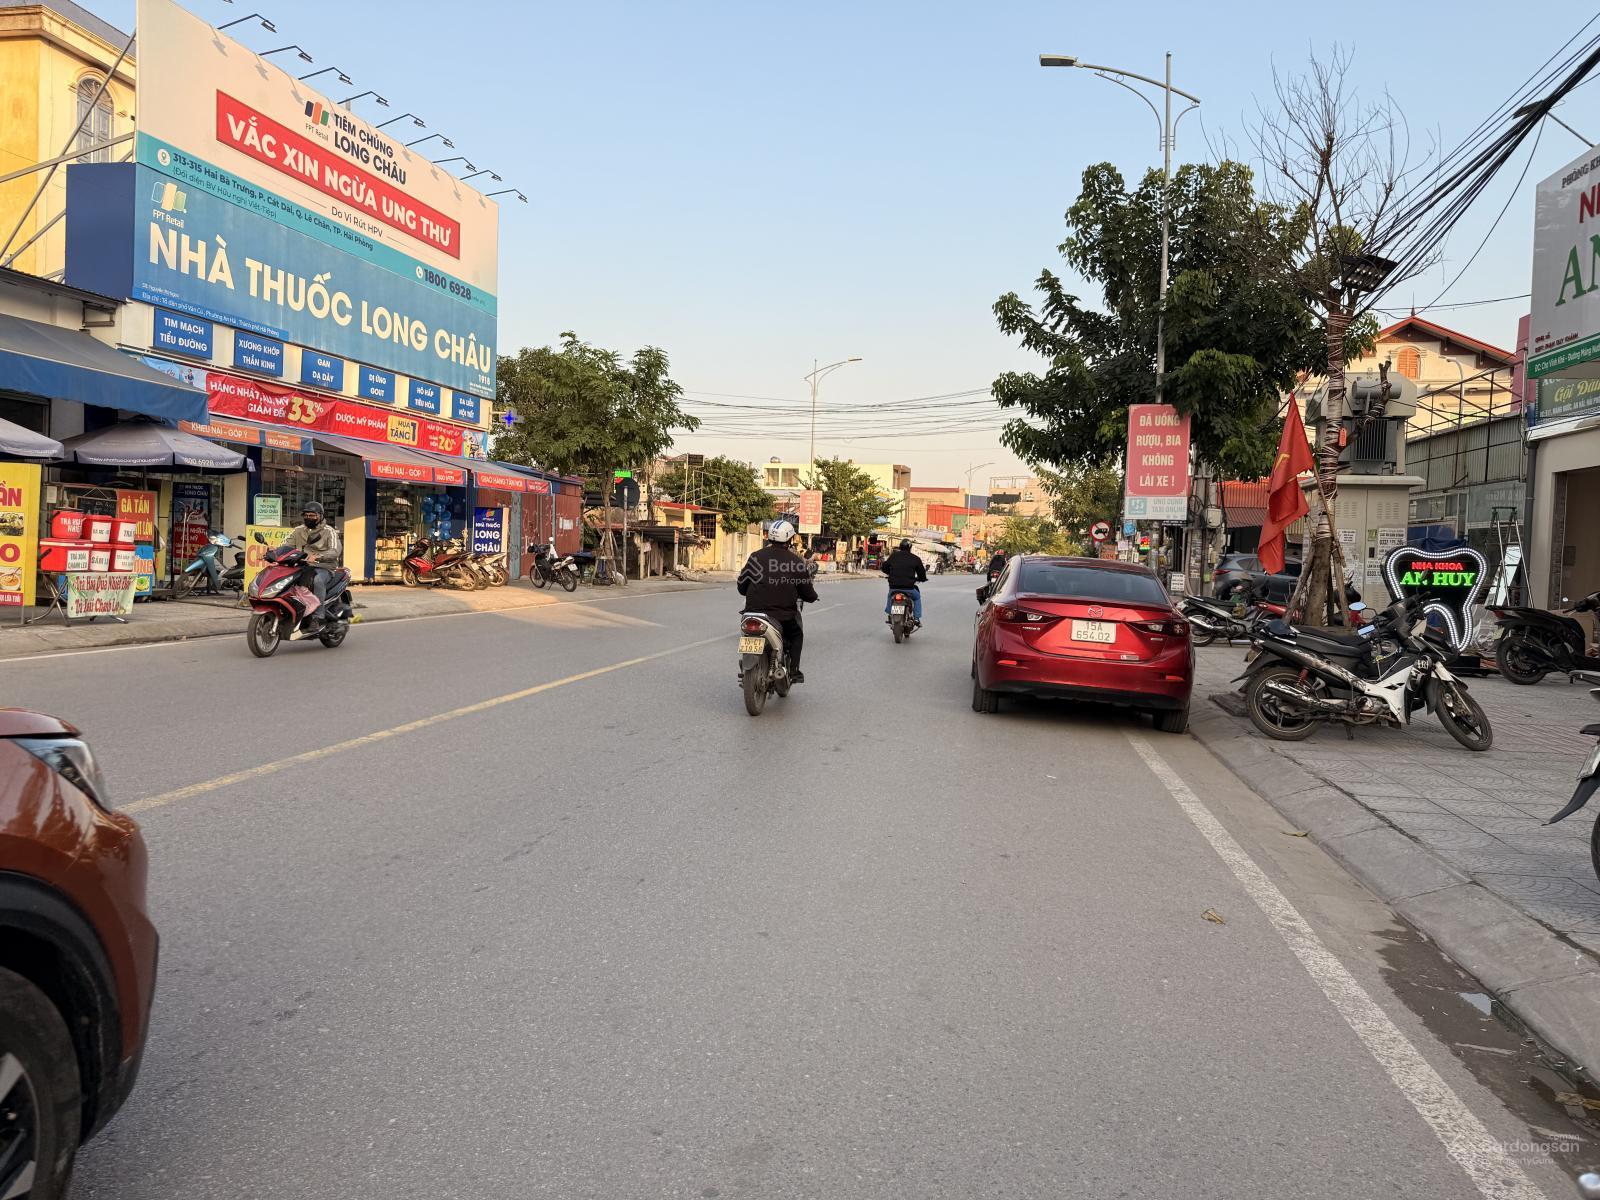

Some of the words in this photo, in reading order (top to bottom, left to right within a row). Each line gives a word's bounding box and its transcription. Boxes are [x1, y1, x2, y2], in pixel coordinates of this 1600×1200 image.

[305, 123, 315, 134] FPT
[316, 128, 329, 142] Retail
[334, 113, 356, 137] TIÊM
[359, 130, 393, 158] CHỦNG
[334, 132, 370, 164] LONG
[373, 154, 406, 185] CHÂU
[226, 113, 277, 159] VẮC
[283, 142, 319, 181] XIN
[325, 165, 377, 211] NGỪA
[382, 196, 417, 230] UNG
[420, 216, 452, 247] THƯ
[1561, 163, 1589, 189] PHÒNG
[206, 181, 217, 192] BV
[173, 152, 202, 172] 313-315
[204, 167, 218, 180] Hai
[219, 173, 231, 186] Bà
[232, 179, 257, 199] Trưng,
[258, 192, 265, 202] P.
[296, 210, 303, 219] Q.
[313, 217, 332, 233] Chân,
[333, 226, 343, 237] TP.
[343, 230, 354, 242] Hải
[354, 237, 374, 252] Phòng
[153, 209, 165, 220] FPT
[166, 214, 184, 228] Retail
[331, 206, 343, 219] Do
[353, 216, 367, 230] Rút
[368, 224, 383, 238] HPV
[424, 268, 447, 291] 1800
[450, 280, 472, 301] 6928
[149, 221, 235, 290] NHÀ
[245, 256, 353, 327] THUỐC
[361, 300, 428, 351] LONG
[434, 329, 491, 373] CHÂU
[164, 317, 178, 329] TIM
[180, 320, 204, 335] MẠCH
[160, 330, 176, 345] TIỂU
[178, 335, 208, 352] ĐƯỜNG
[239, 339, 262, 352] XƯƠNG
[263, 343, 280, 356] KHỚP
[261, 360, 275, 370] KINH
[317, 358, 331, 369] GAN
[312, 371, 321, 380] DẠ
[210, 381, 235, 395] HÀNG
[275, 395, 289, 406] MỸ
[370, 387, 385, 397] GOUT
[247, 402, 272, 417] GIẢM
[335, 412, 356, 426] DƯỢC
[356, 415, 367, 425] MỸ
[397, 420, 411, 429] MUA
[1140, 413, 1152, 427] ĐÃ
[1155, 411, 1180, 427] UỐNG
[390, 428, 411, 440] TẶNG
[1136, 434, 1163, 449] RƯỢU,
[1165, 435, 1181, 446] BIA
[1142, 453, 1174, 466] KHÔNG
[1140, 473, 1153, 487] LÁI
[1156, 475, 1168, 487] XE
[121, 497, 132, 514] GÀ
[475, 530, 499, 539] LONG
[474, 540, 499, 553] CHÂU
[1411, 561, 1433, 571] NHA
[1435, 562, 1464, 571] KHOA
[1432, 571, 1476, 587] HUY
[1084, 621, 1103, 631] 15A
[1076, 630, 1111, 642] 654.02
